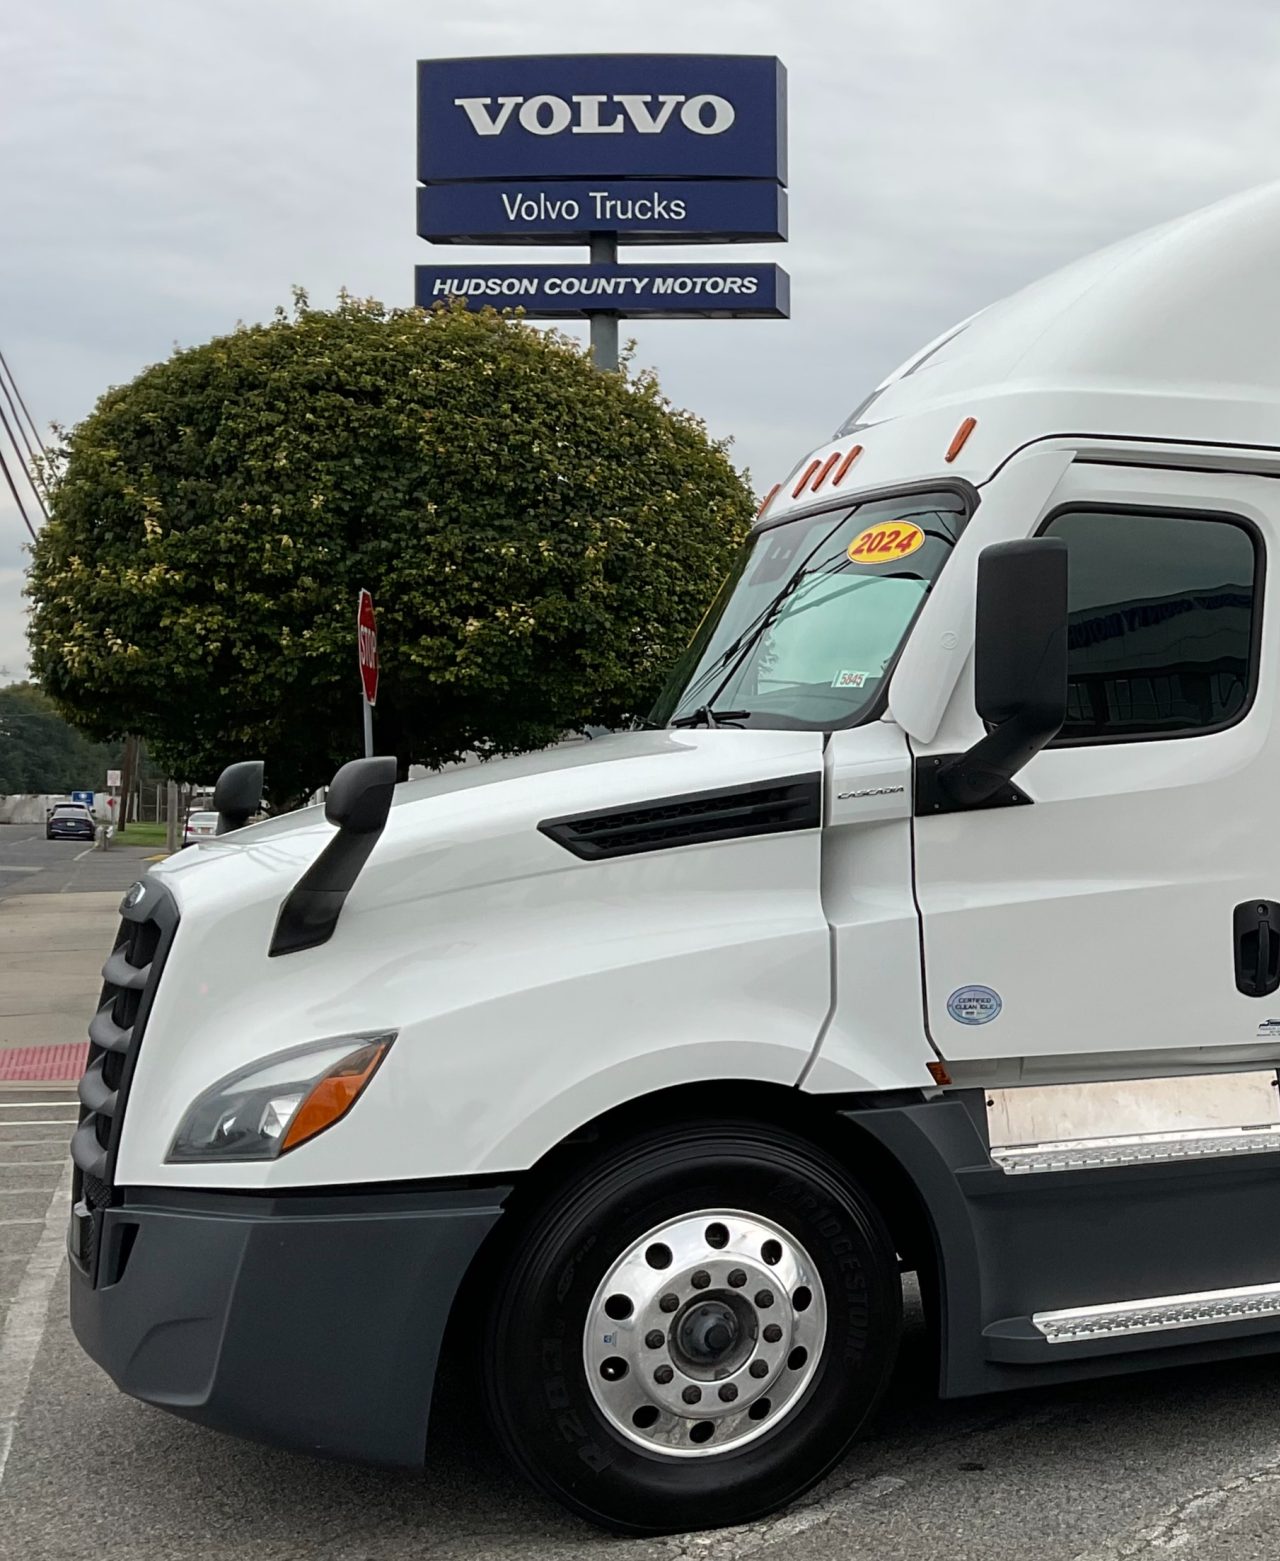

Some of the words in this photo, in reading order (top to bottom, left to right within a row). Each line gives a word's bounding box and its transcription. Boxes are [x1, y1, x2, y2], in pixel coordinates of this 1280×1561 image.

[454, 94, 736, 136] VOLVO
[502, 192, 580, 221] Volvo
[588, 191, 687, 220] Trucks
[432, 277, 539, 296] HUDSON
[543, 277, 650, 295] COUNTY
[652, 276, 759, 294] MOTORS
[851, 529, 919, 555] 2024
[837, 785, 904, 800] CASCADIA
